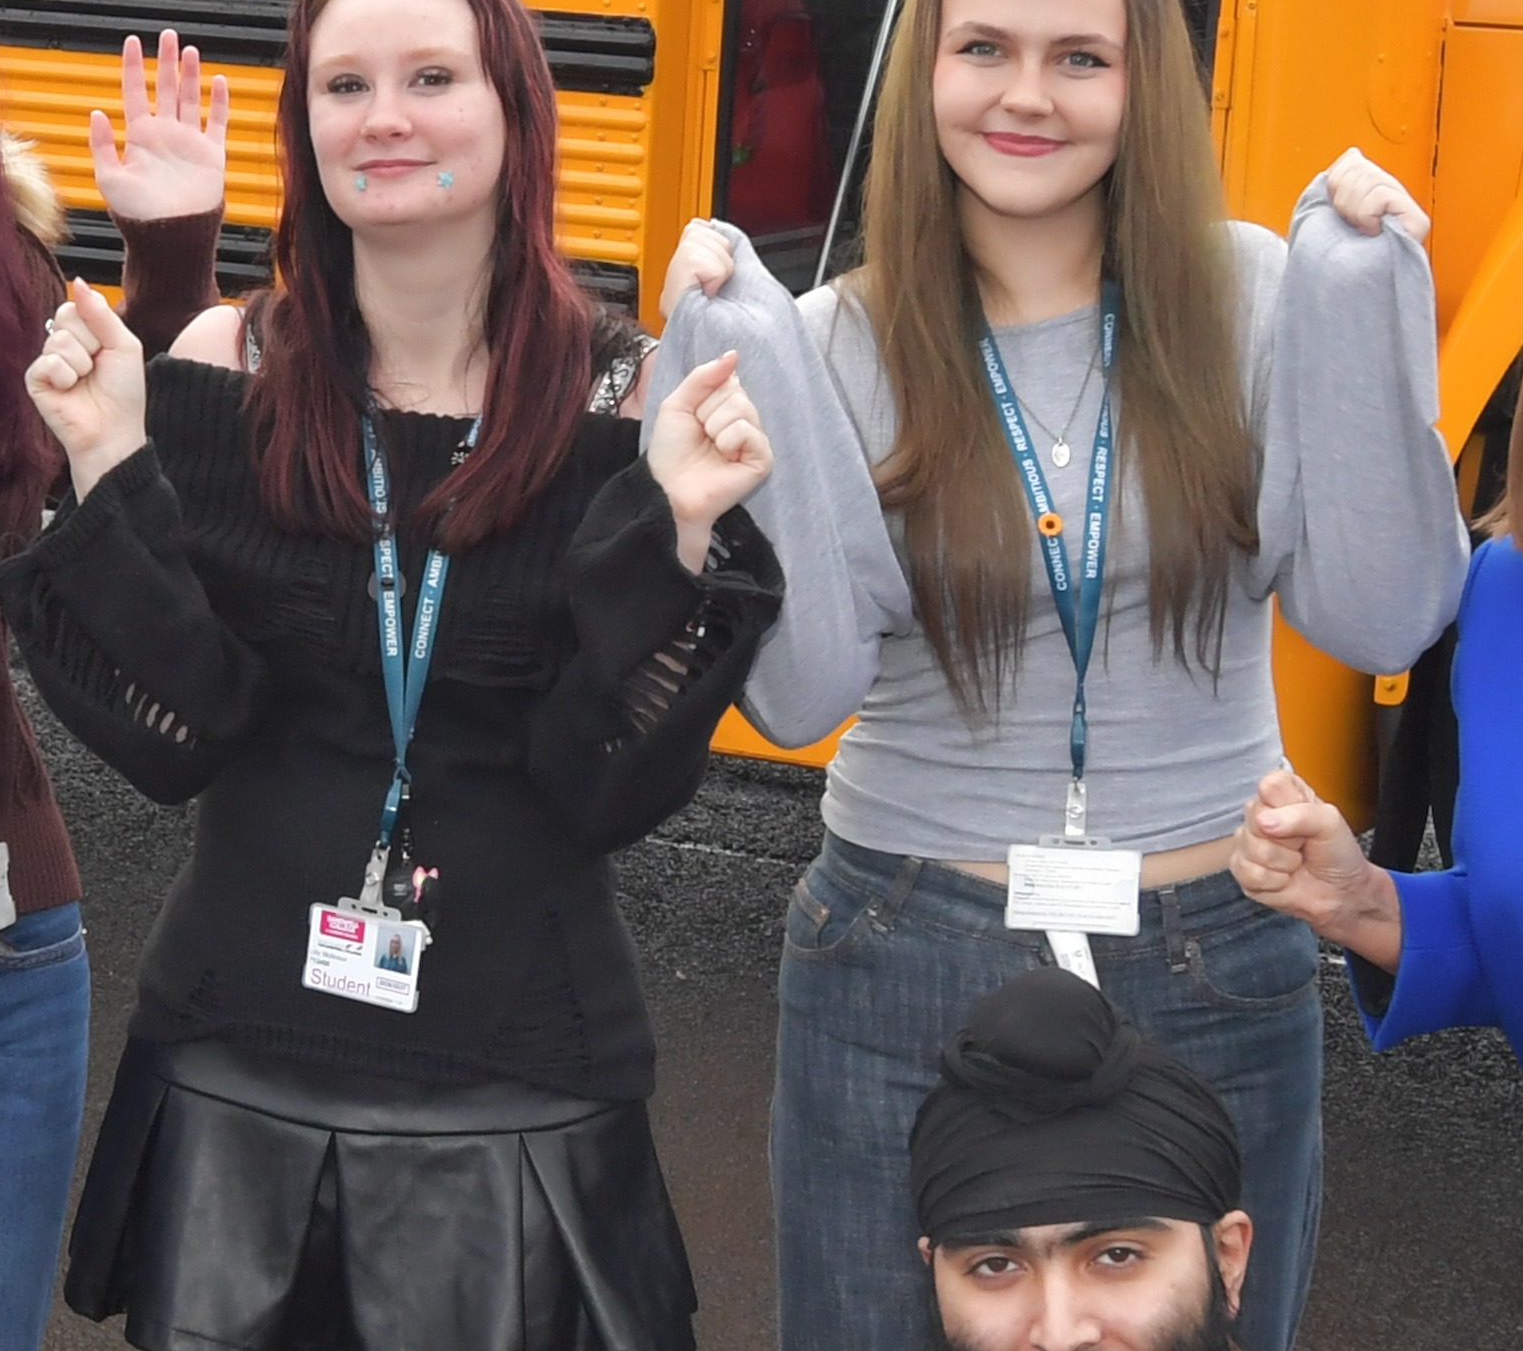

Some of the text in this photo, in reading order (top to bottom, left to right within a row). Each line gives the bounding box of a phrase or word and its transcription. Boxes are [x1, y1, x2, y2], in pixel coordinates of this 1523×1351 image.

[1001, 401, 1029, 452] RESPECT
[1021, 459, 1051, 514] MBITIOUS
[1092, 448, 1108, 503] RESPECT
[1046, 537, 1068, 592] CONNEC
[1085, 513, 1101, 579] EMPOWER
[383, 590, 397, 657] EMPOWER
[415, 597, 434, 659] CONNECT
[311, 968, 371, 996] Student
